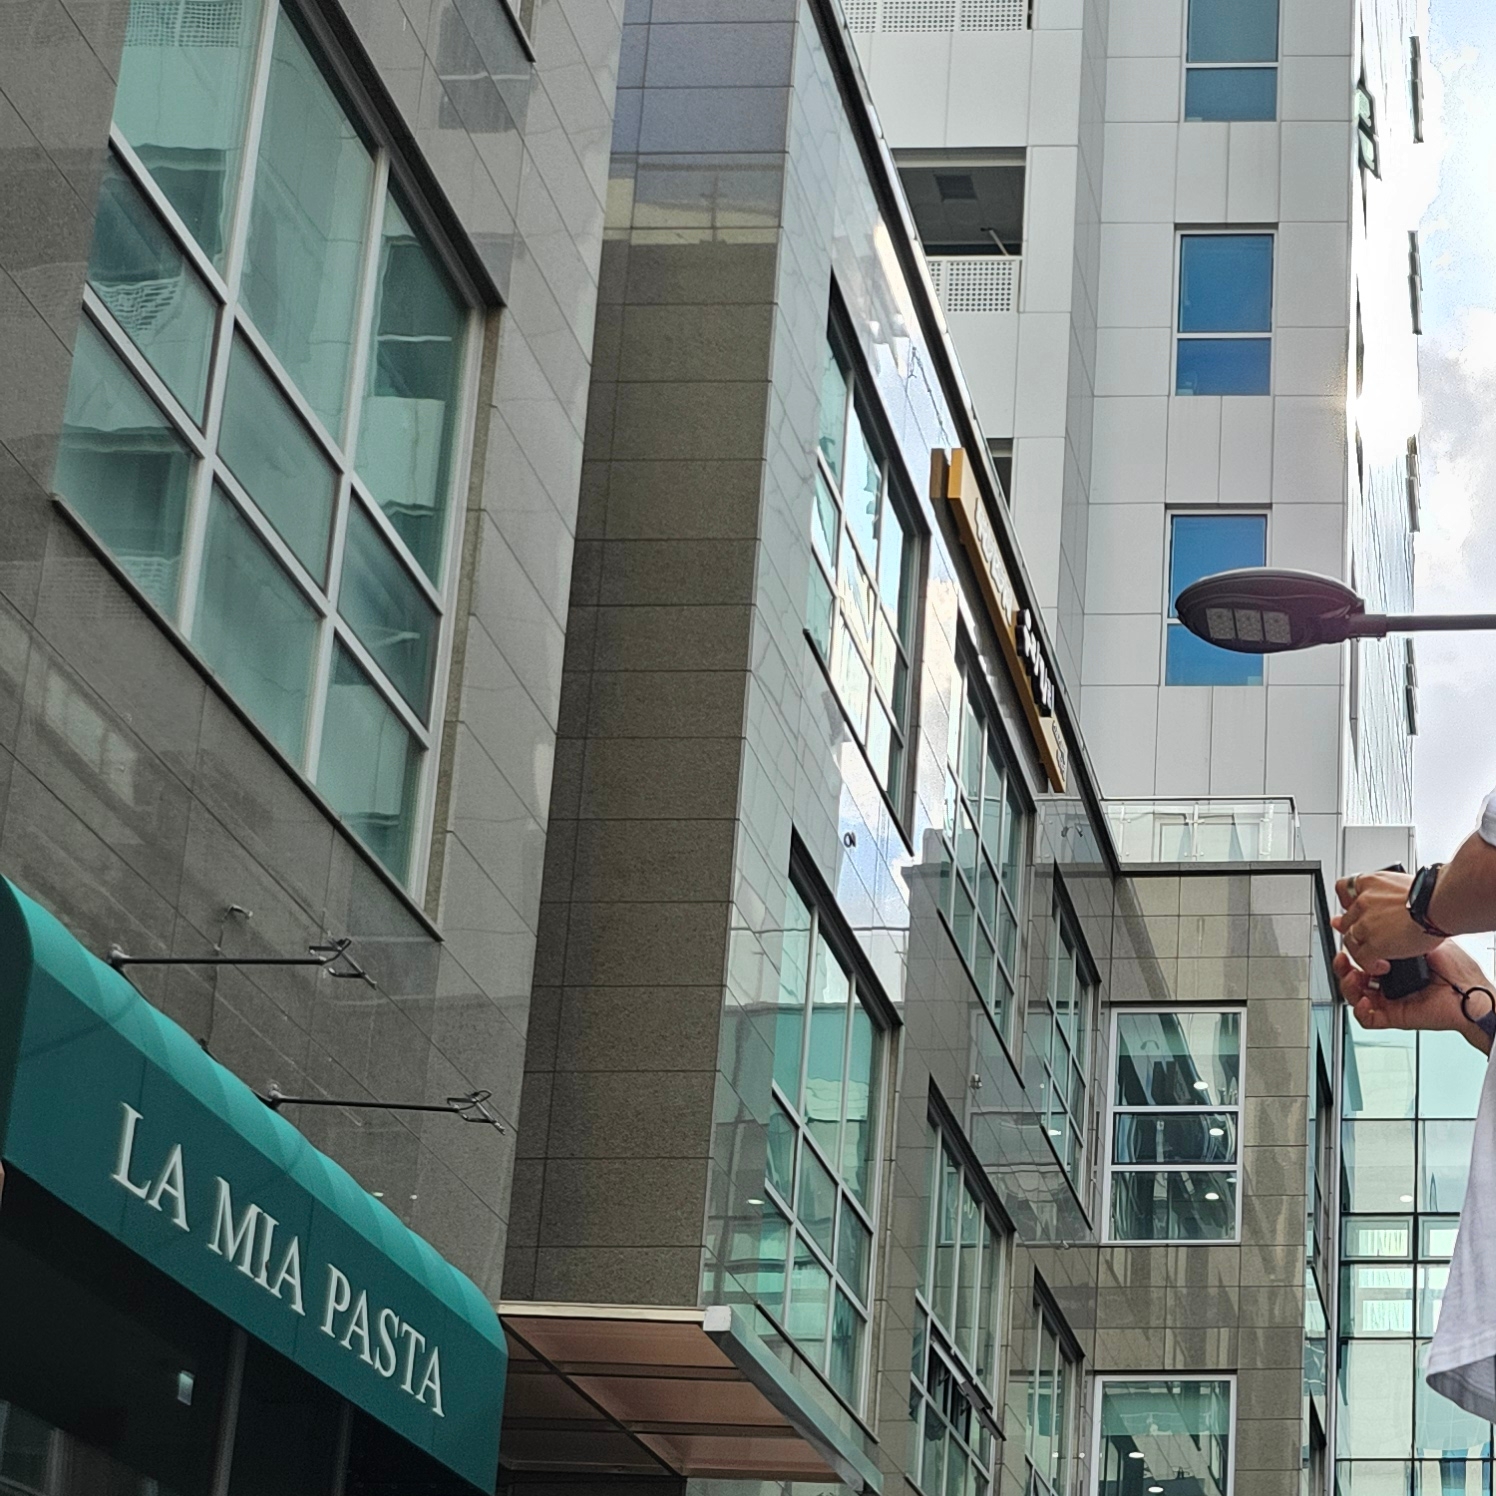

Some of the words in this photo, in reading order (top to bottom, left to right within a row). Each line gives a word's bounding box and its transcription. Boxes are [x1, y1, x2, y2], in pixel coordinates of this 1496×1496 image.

[111, 1102, 191, 1232] LA
[207, 1175, 305, 1316] MIA
[320, 1263, 446, 1417] PASTA
